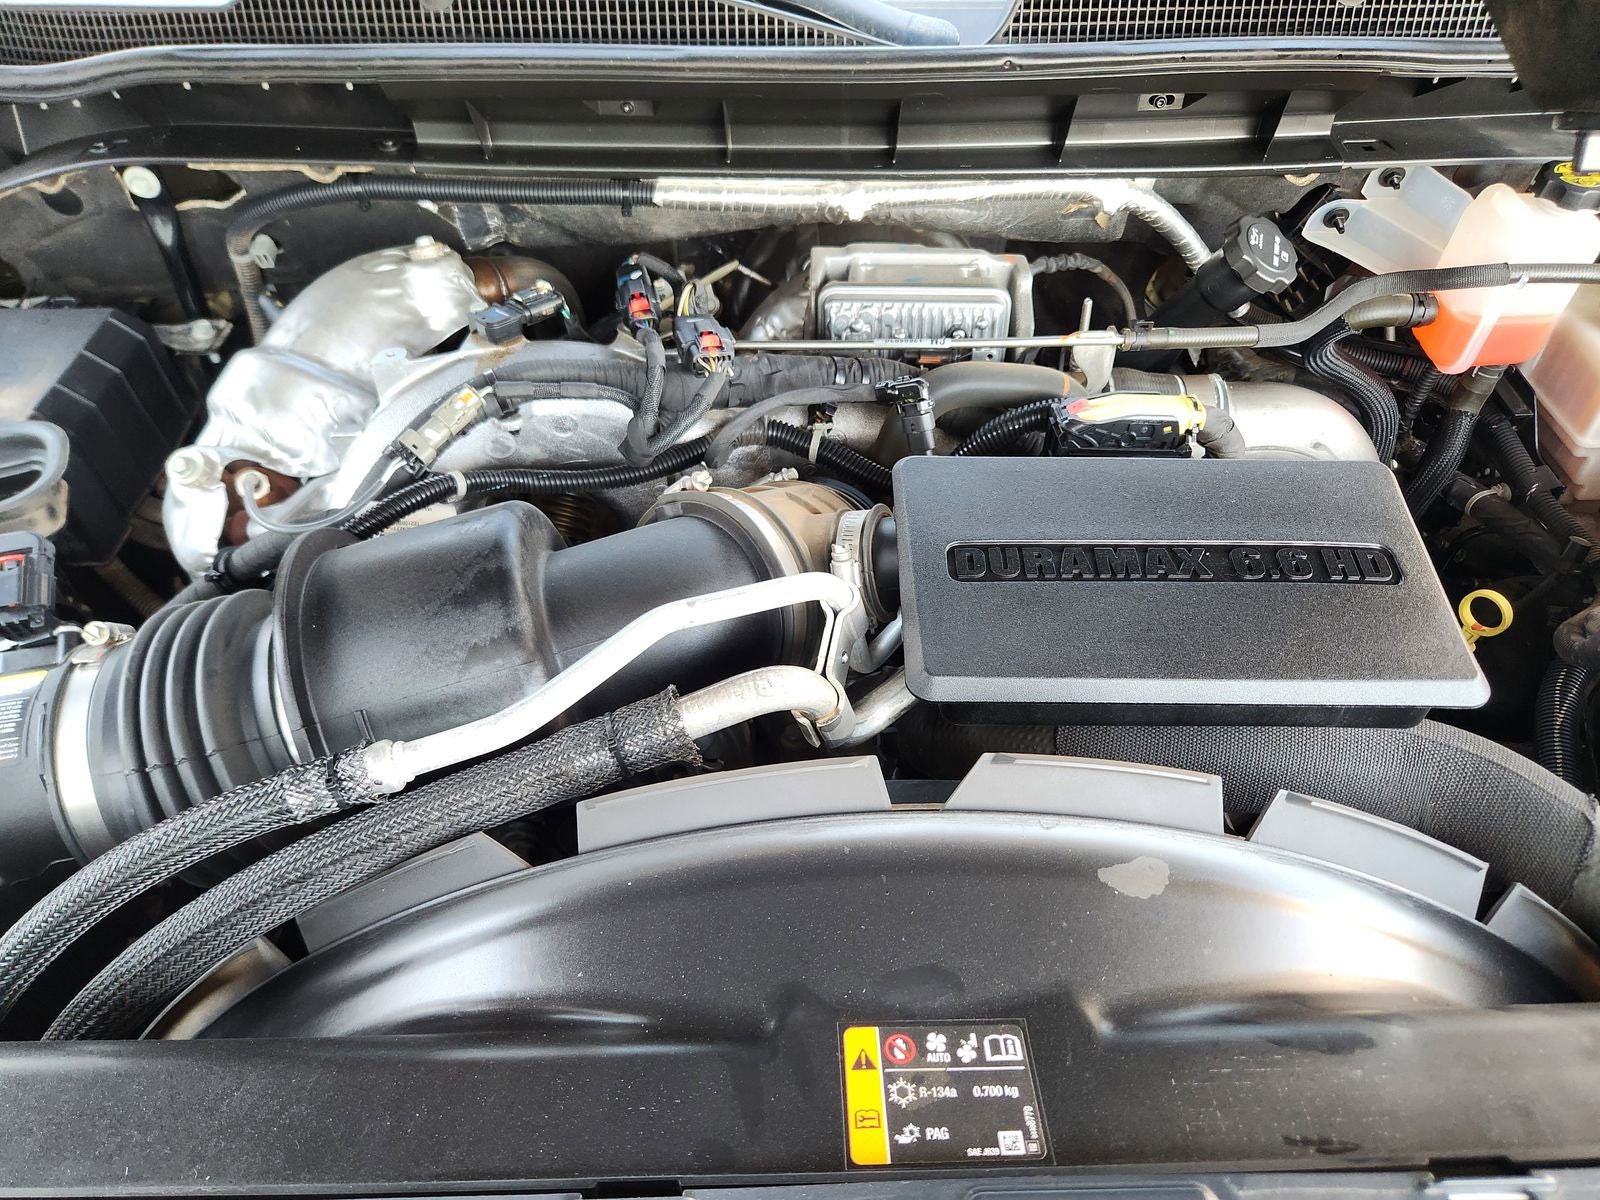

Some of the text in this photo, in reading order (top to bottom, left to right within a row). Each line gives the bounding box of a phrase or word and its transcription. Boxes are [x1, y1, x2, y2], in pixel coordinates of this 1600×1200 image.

[954, 547, 1394, 582] DURAMAX 6.6 HD
[926, 1053, 951, 1063] AUTO
[919, 1087, 958, 1098] R-134a
[1004, 1085, 1019, 1098] kg
[925, 1127, 950, 1141] PAG
[966, 1147, 982, 1157] SAE
